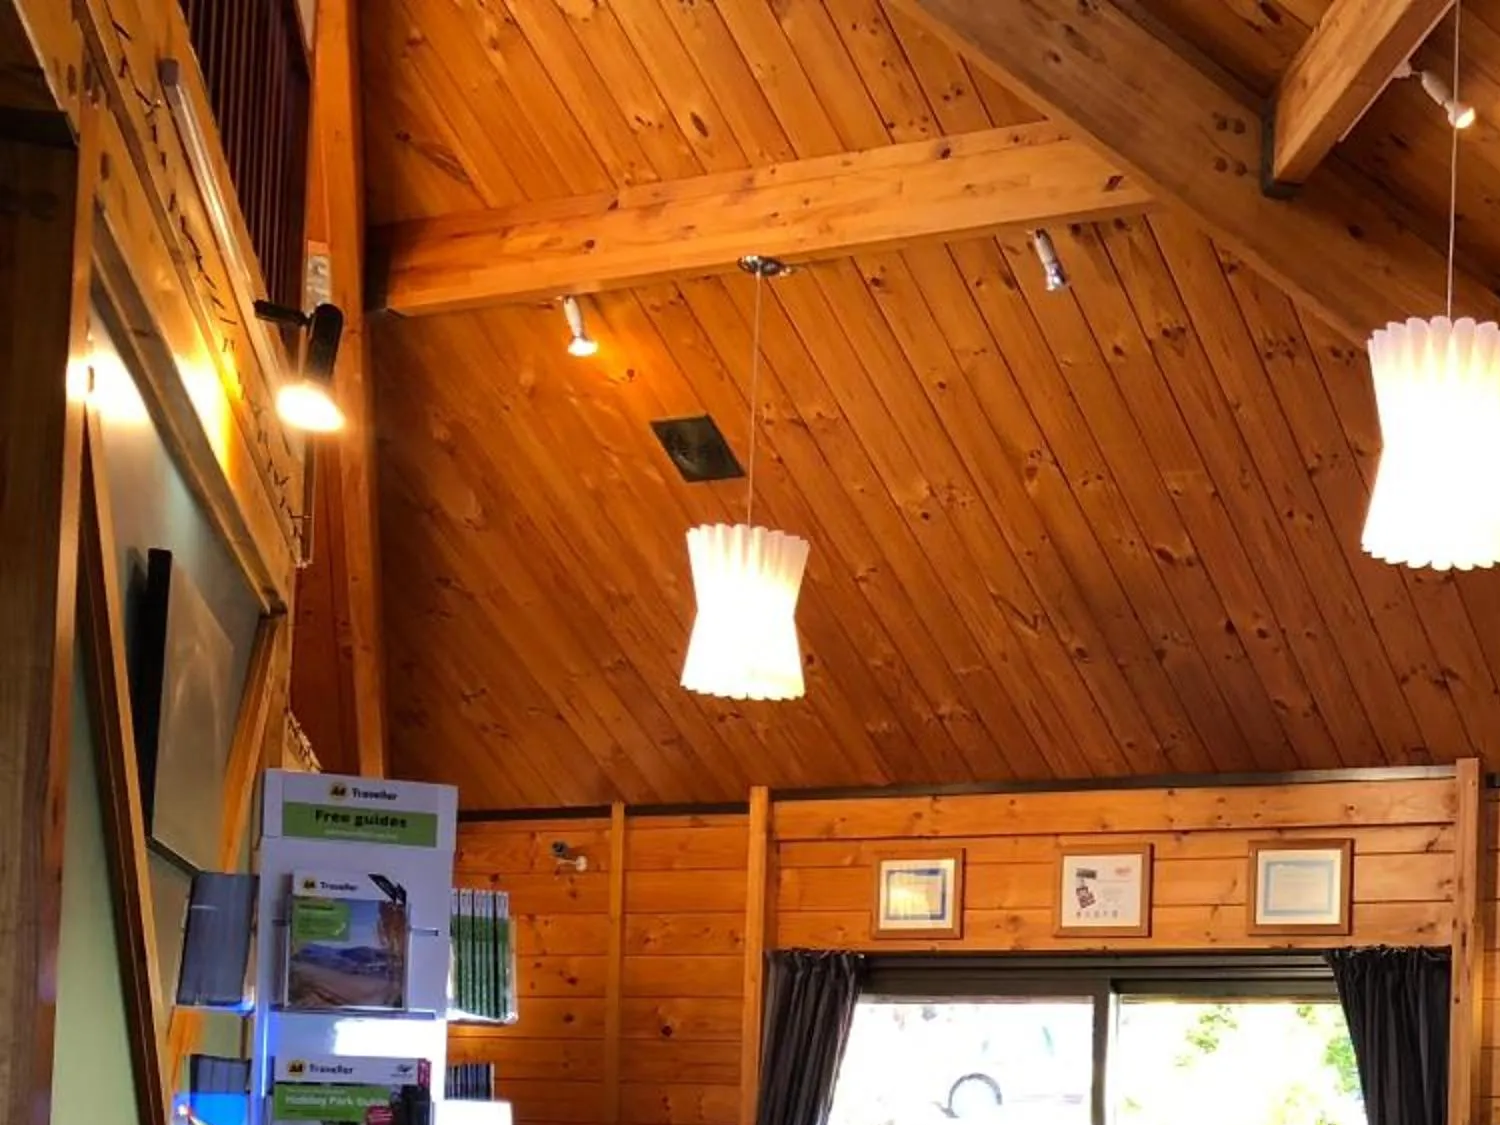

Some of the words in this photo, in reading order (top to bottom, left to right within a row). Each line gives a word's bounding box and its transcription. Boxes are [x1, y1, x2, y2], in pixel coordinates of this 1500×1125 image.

[352, 788, 398, 800] Traveller
[315, 809, 350, 823] Free
[354, 814, 408, 828] guides
[320, 881, 358, 891] Traveller
[310, 1064, 353, 1075] Traveller
